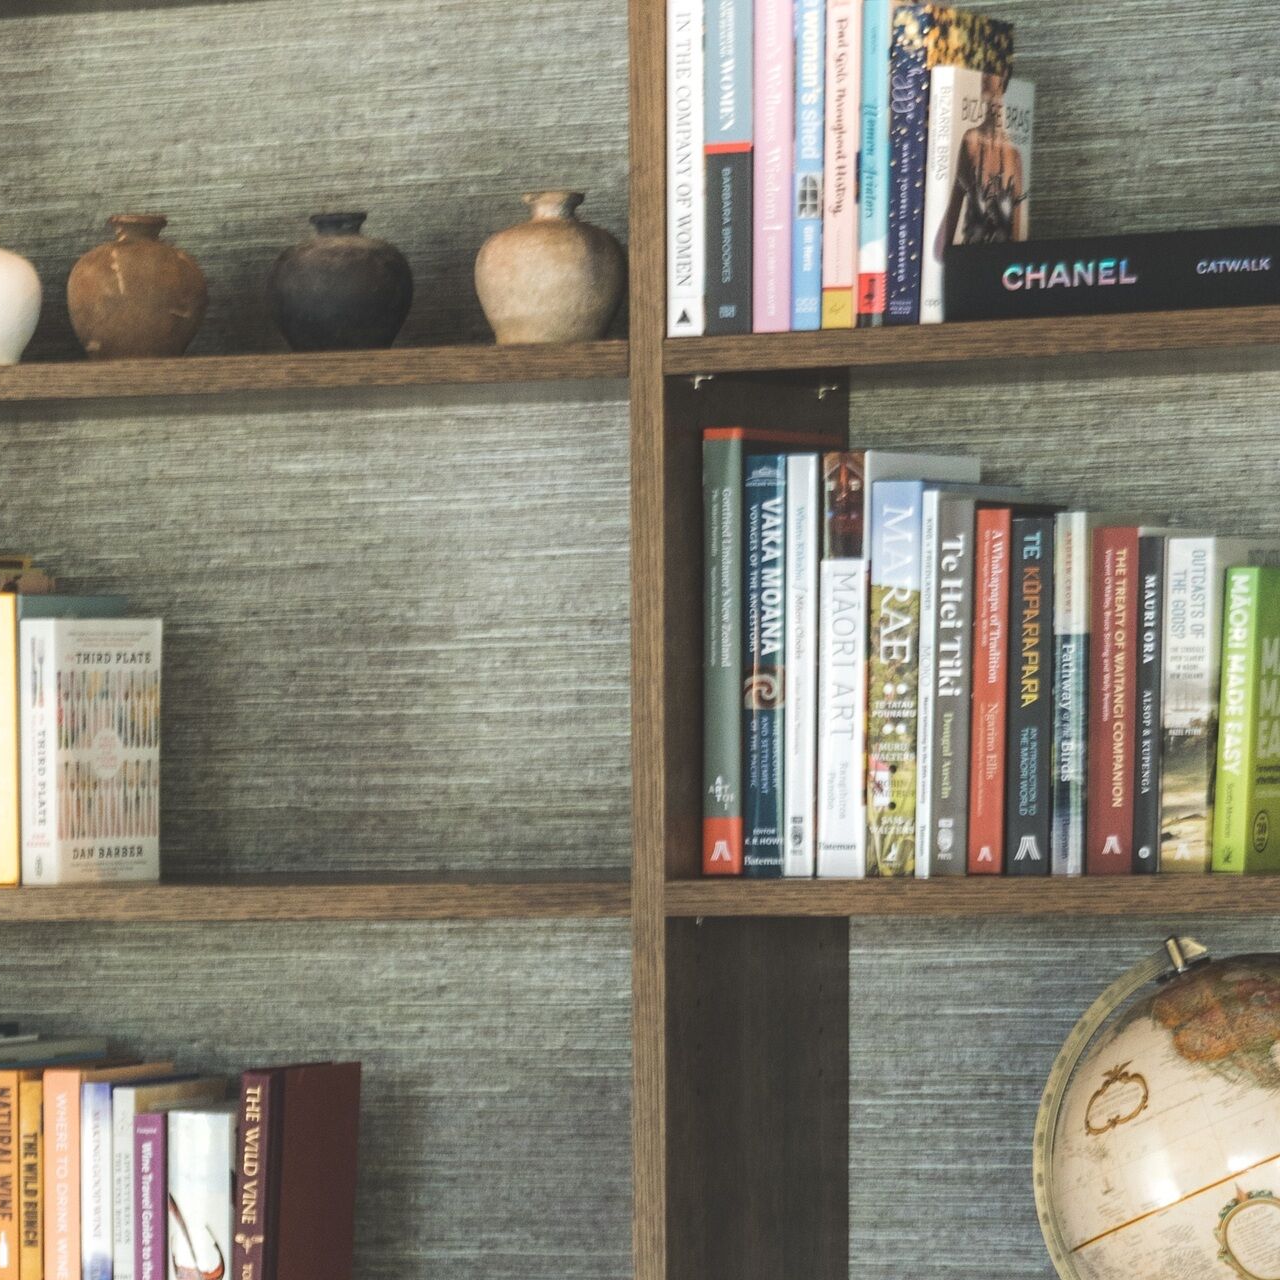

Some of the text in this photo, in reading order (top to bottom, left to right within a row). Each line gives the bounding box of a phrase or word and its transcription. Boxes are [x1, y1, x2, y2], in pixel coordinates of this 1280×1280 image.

[719, 60, 736, 132] WOMEN
[799, 11, 821, 160] woman's shed
[675, 12, 694, 287] IN THE COMPANY OF WOMEN
[934, 86, 952, 181] BIZARRE BRAS
[719, 167, 733, 284] BARBARA BROOKES
[1196, 257, 1271, 275] CATWALK
[1001, 257, 1138, 291] CHANEL
[720, 488, 733, 668] Gottfried Lindauer's New Zealand
[760, 497, 782, 656] VAKA MOANA
[879, 504, 911, 665] MARAE
[937, 534, 965, 697] Te Hei Tiki
[1143, 574, 1158, 665] MAURI ORA
[1190, 549, 1207, 640] OUTCASTS OF
[75, 652, 152, 665] THIRD PLATE
[829, 571, 859, 741] MĀORI ART
[1111, 548, 1127, 808] THE TREATY OF WAITANGI COMPANION
[1221, 572, 1252, 776] MĀORI MADE EASY
[36, 730, 48, 827] THIRD PLATE
[1140, 690, 1154, 795] ALSOP & KUPENGA
[72, 846, 144, 860] DAN BARBER
[53, 1092, 69, 1152] WHERE
[55, 1157, 69, 1178] TO
[141, 1140, 157, 1173] Wine
[240, 1084, 262, 1225] THE WILD VINE
[22, 1131, 39, 1249] THE WILD BUNCH
[55, 1182, 69, 1233] DRINK
[141, 1173, 157, 1210] Travel
[141, 1210, 156, 1243] Guide
[141, 1245, 156, 1262] to
[141, 1263, 156, 1280] the
